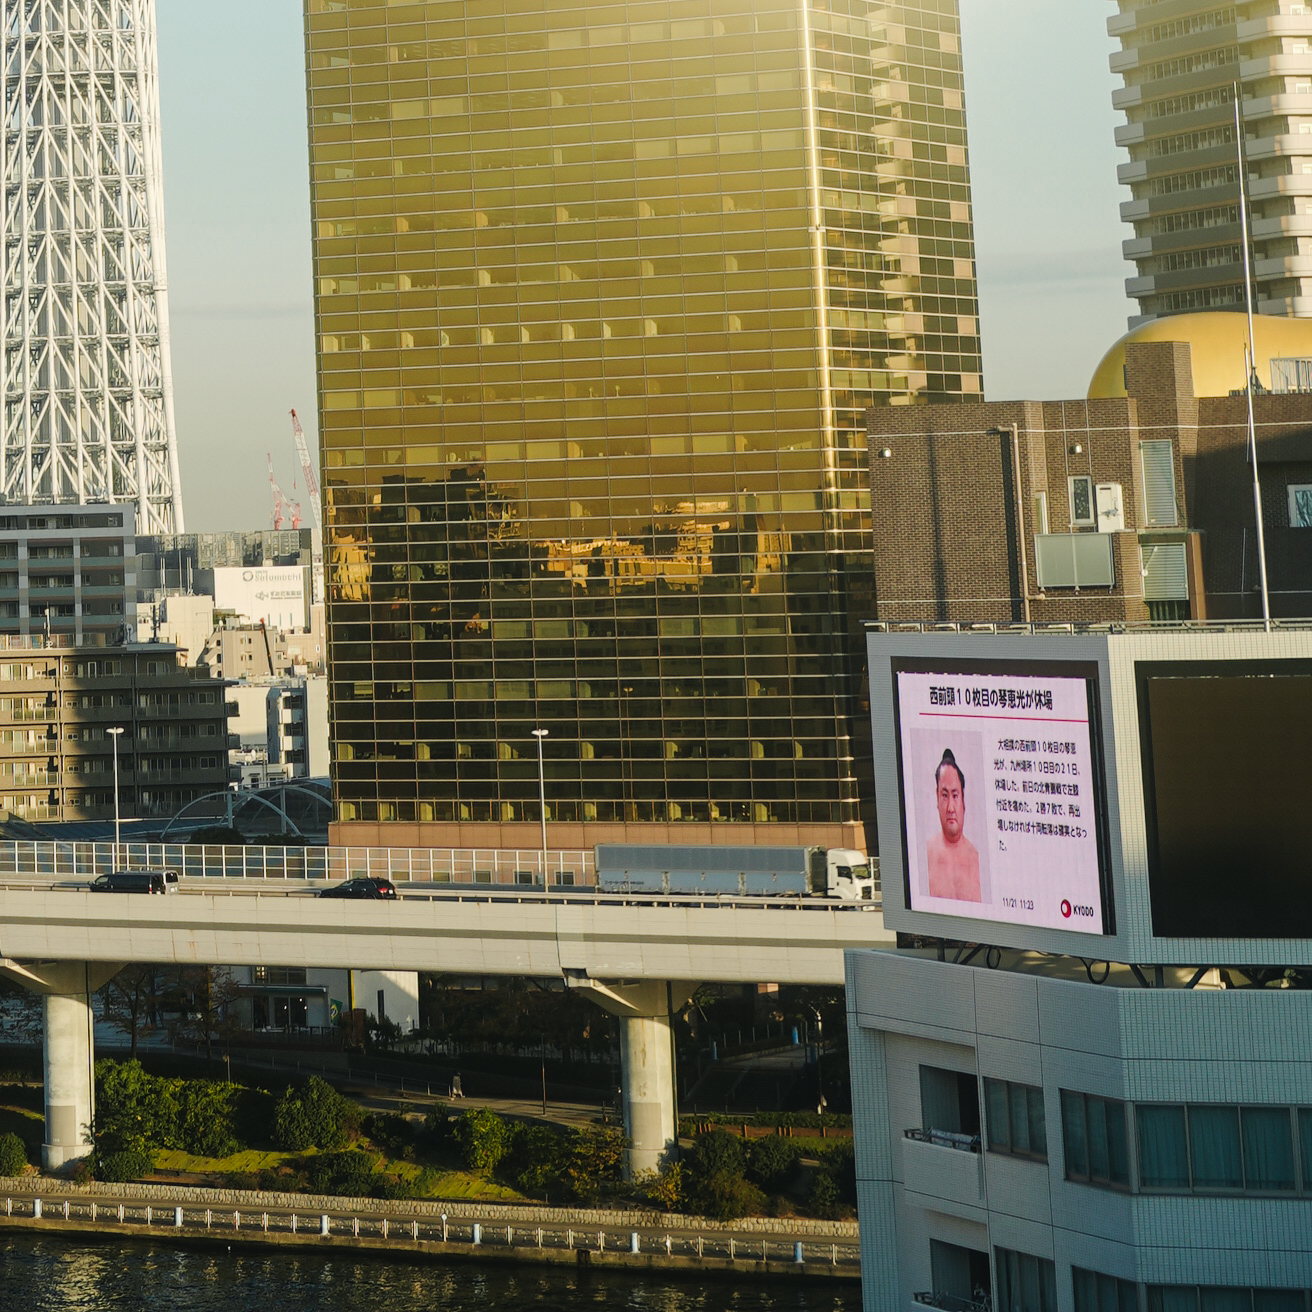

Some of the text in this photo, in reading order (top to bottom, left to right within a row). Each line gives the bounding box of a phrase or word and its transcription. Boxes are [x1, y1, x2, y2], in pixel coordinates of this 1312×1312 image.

[1002, 898, 1034, 910] 11/21 11:23
[1073, 905, 1094, 917] KYODO
